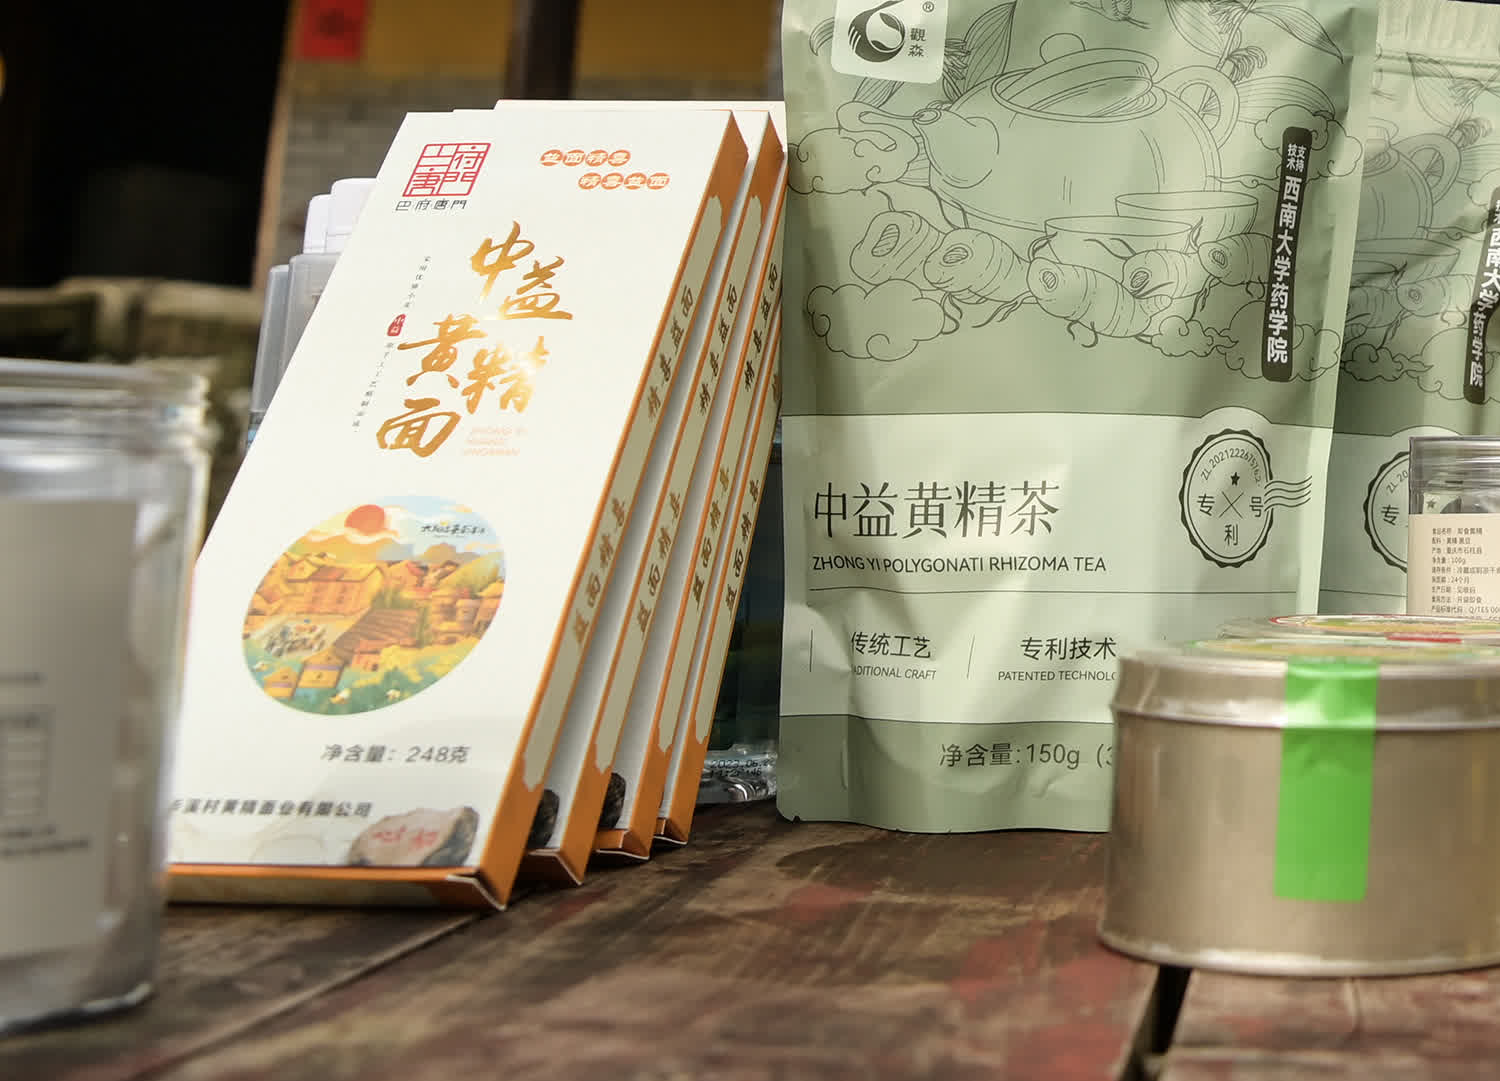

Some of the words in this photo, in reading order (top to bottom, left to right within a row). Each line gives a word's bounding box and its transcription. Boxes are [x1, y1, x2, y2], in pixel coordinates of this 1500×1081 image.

[395, 199, 467, 211] 巴府唐門
[470, 221, 573, 320] 中益
[1267, 175, 1302, 364] 西南大学药学院
[397, 313, 550, 415] 黄精
[376, 398, 461, 458] 面
[1200, 468, 1213, 480] ZL
[1386, 481, 1399, 494] ZL
[813, 479, 1061, 540] 中益黄精茶
[1380, 504, 1400, 525] 专
[812, 555, 866, 571] ZHONG
[867, 556, 881, 572] YI
[883, 556, 985, 573] POLYGONATI
[989, 555, 1069, 572] RHIZOMA
[1074, 556, 1107, 572] TEA
[850, 631, 932, 659] 传统工艺
[1020, 636, 1117, 661] 专利技术
[904, 668, 937, 681] CRAFT
[998, 670, 1055, 681] PATENTED
